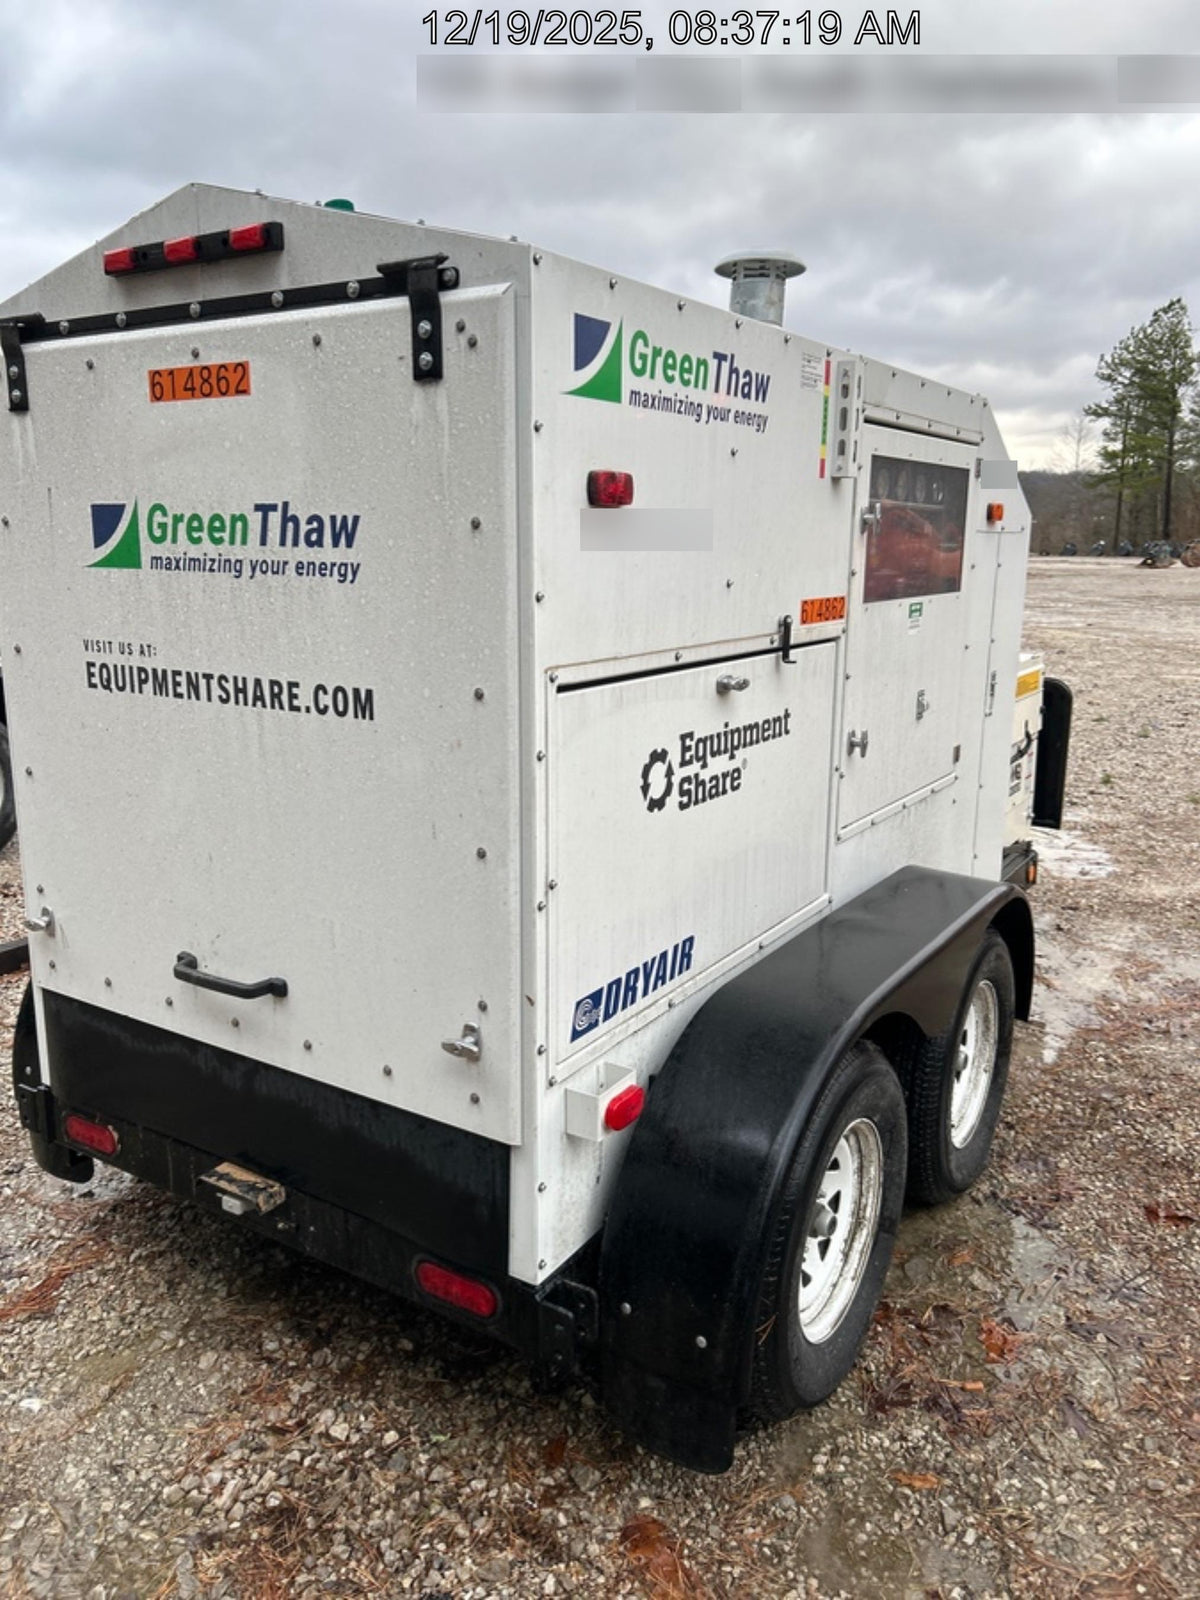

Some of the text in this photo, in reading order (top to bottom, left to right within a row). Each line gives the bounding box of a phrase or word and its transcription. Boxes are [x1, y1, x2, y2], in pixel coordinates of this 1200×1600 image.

[151, 362, 248, 401] 614862
[629, 389, 769, 433] maximizing your energy
[150, 552, 361, 583] maximizing your energy
[801, 597, 846, 625] 614862
[83, 639, 157, 657] VISIT US AT:
[86, 661, 375, 721] EQUIPMENTSHARE.COM
[679, 708, 791, 770] Equipment
[602, 935, 695, 1023] DRYAIR
